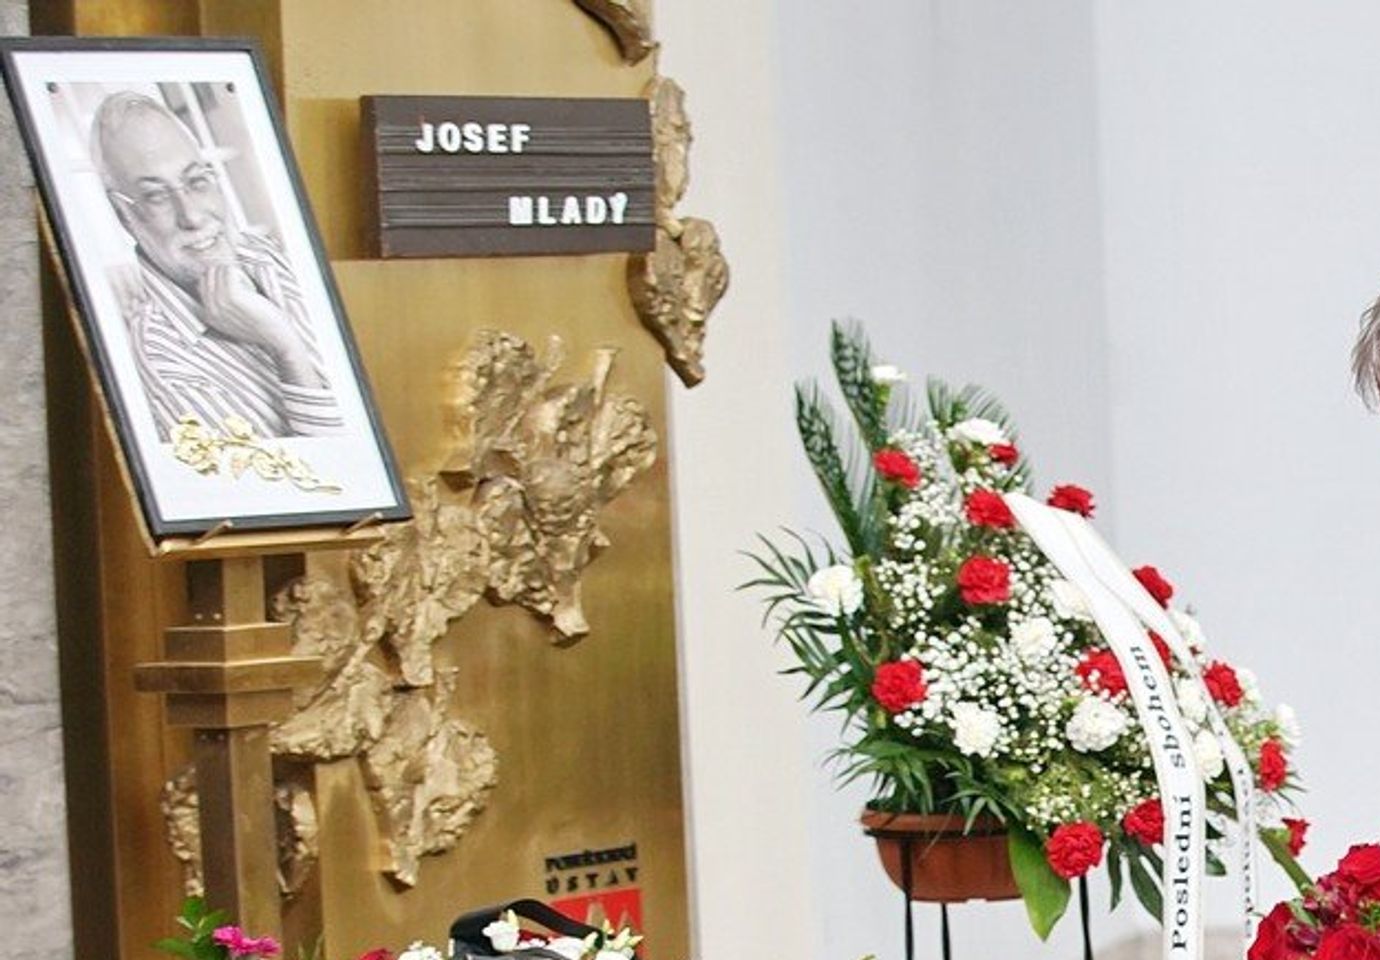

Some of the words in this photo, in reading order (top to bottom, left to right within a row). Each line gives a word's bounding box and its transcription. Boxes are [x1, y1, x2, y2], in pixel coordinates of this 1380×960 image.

[415, 121, 531, 153] JOSEF
[508, 192, 628, 224] MLADÝ
[1130, 645, 1187, 769] sbohem
[1172, 795, 1192, 951] Poslední
